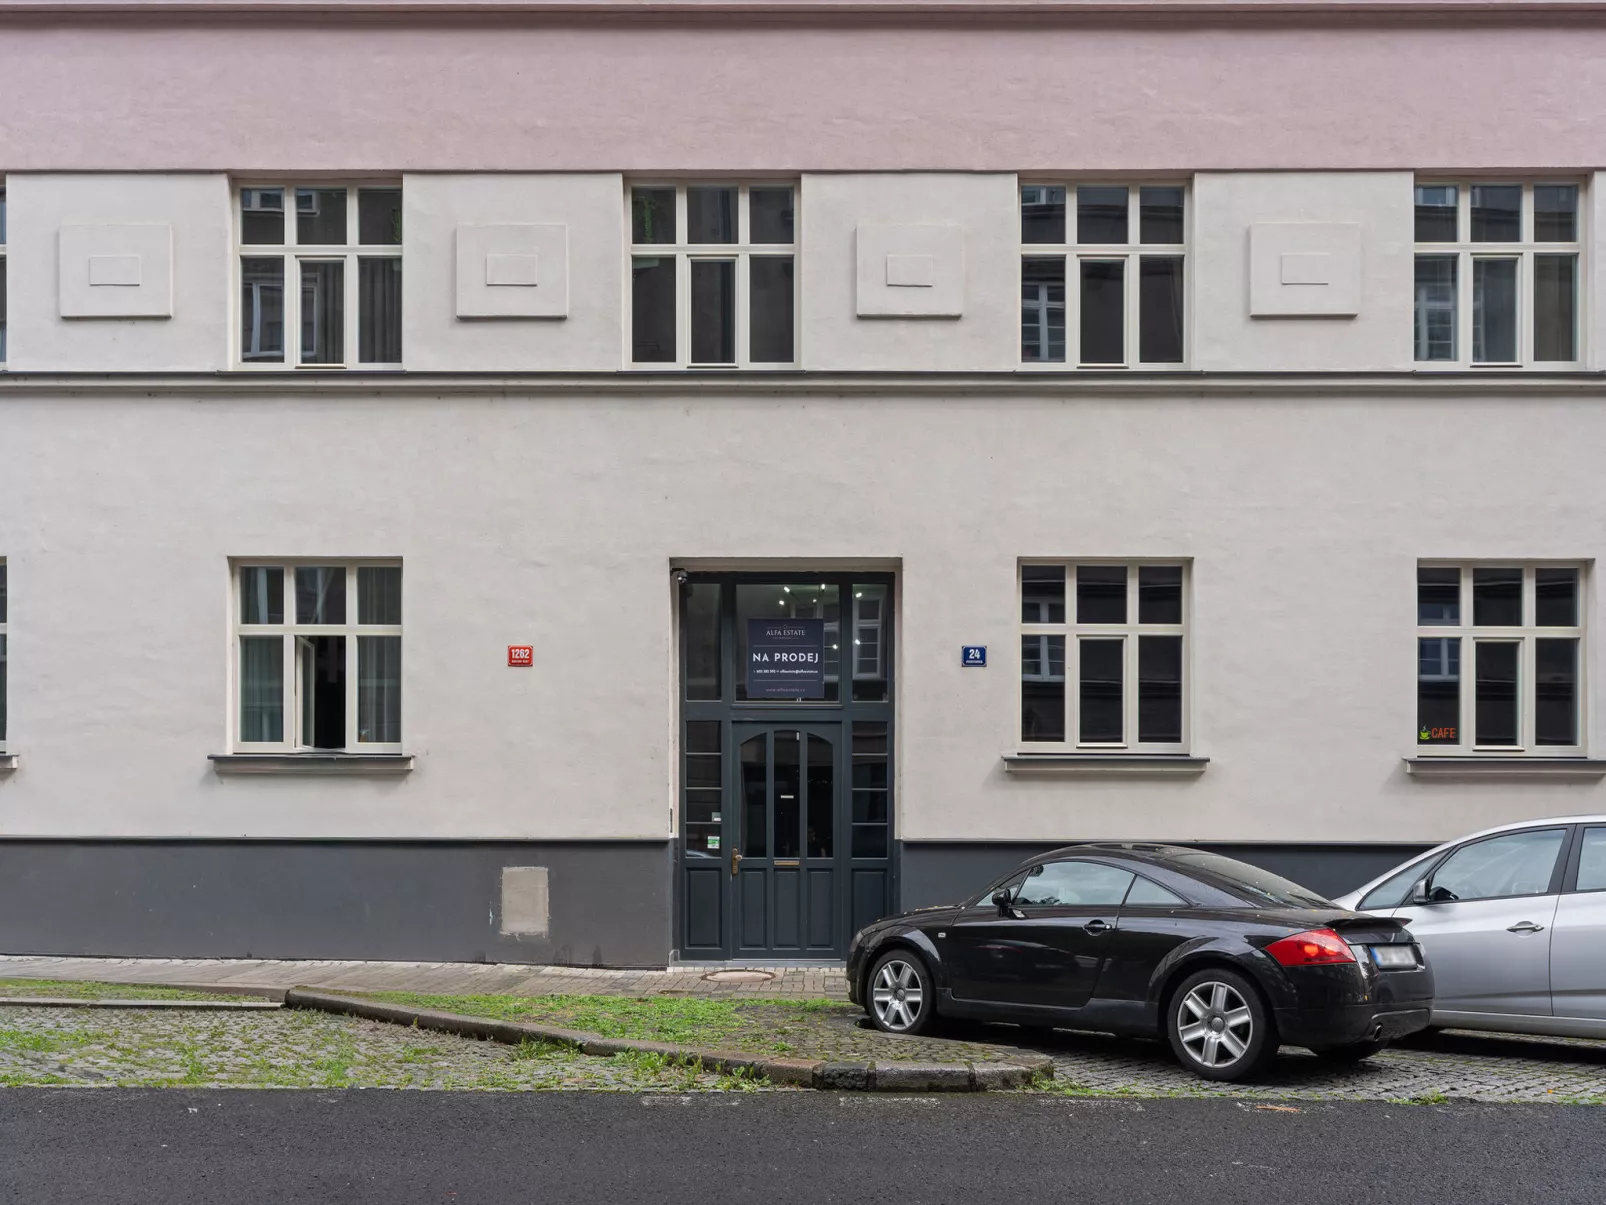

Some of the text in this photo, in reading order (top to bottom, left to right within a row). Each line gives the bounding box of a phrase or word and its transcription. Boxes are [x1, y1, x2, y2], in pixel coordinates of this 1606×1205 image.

[511, 648, 530, 659] 1262
[752, 652, 819, 664] NA PRODEJ
[968, 648, 981, 659] 24
[1431, 727, 1456, 739] CAFE
